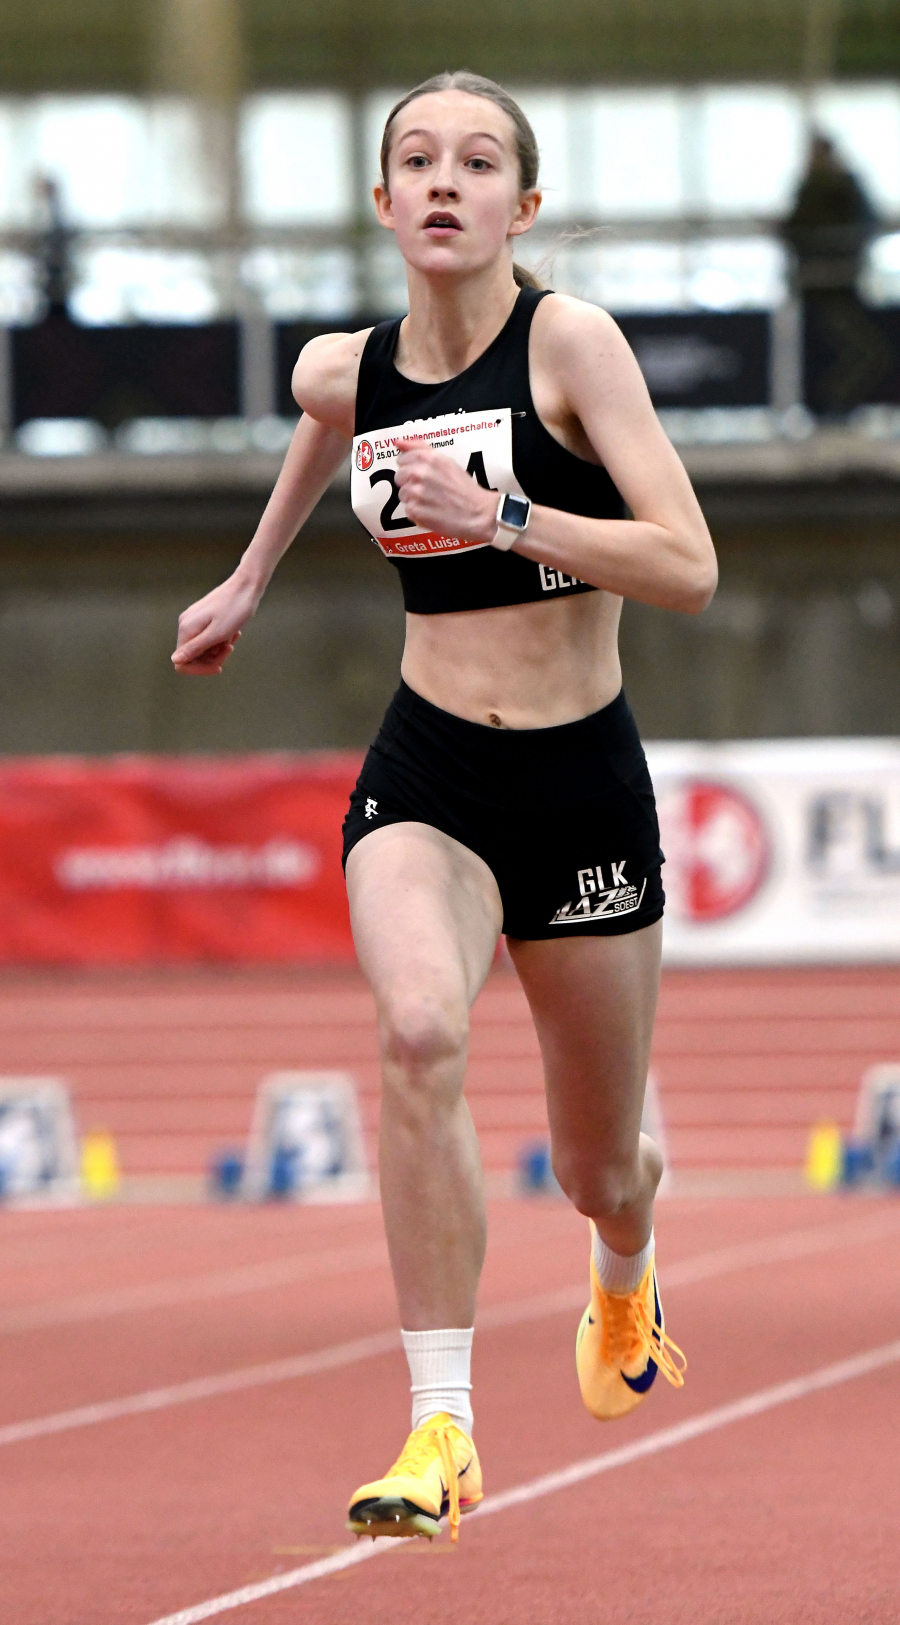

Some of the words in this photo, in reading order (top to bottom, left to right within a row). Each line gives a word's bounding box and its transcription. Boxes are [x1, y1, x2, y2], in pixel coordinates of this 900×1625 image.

[395, 542, 427, 553] Greta
[427, 536, 460, 550] Luisa
[577, 860, 628, 897] GLK
[614, 897, 638, 913] SOEST
